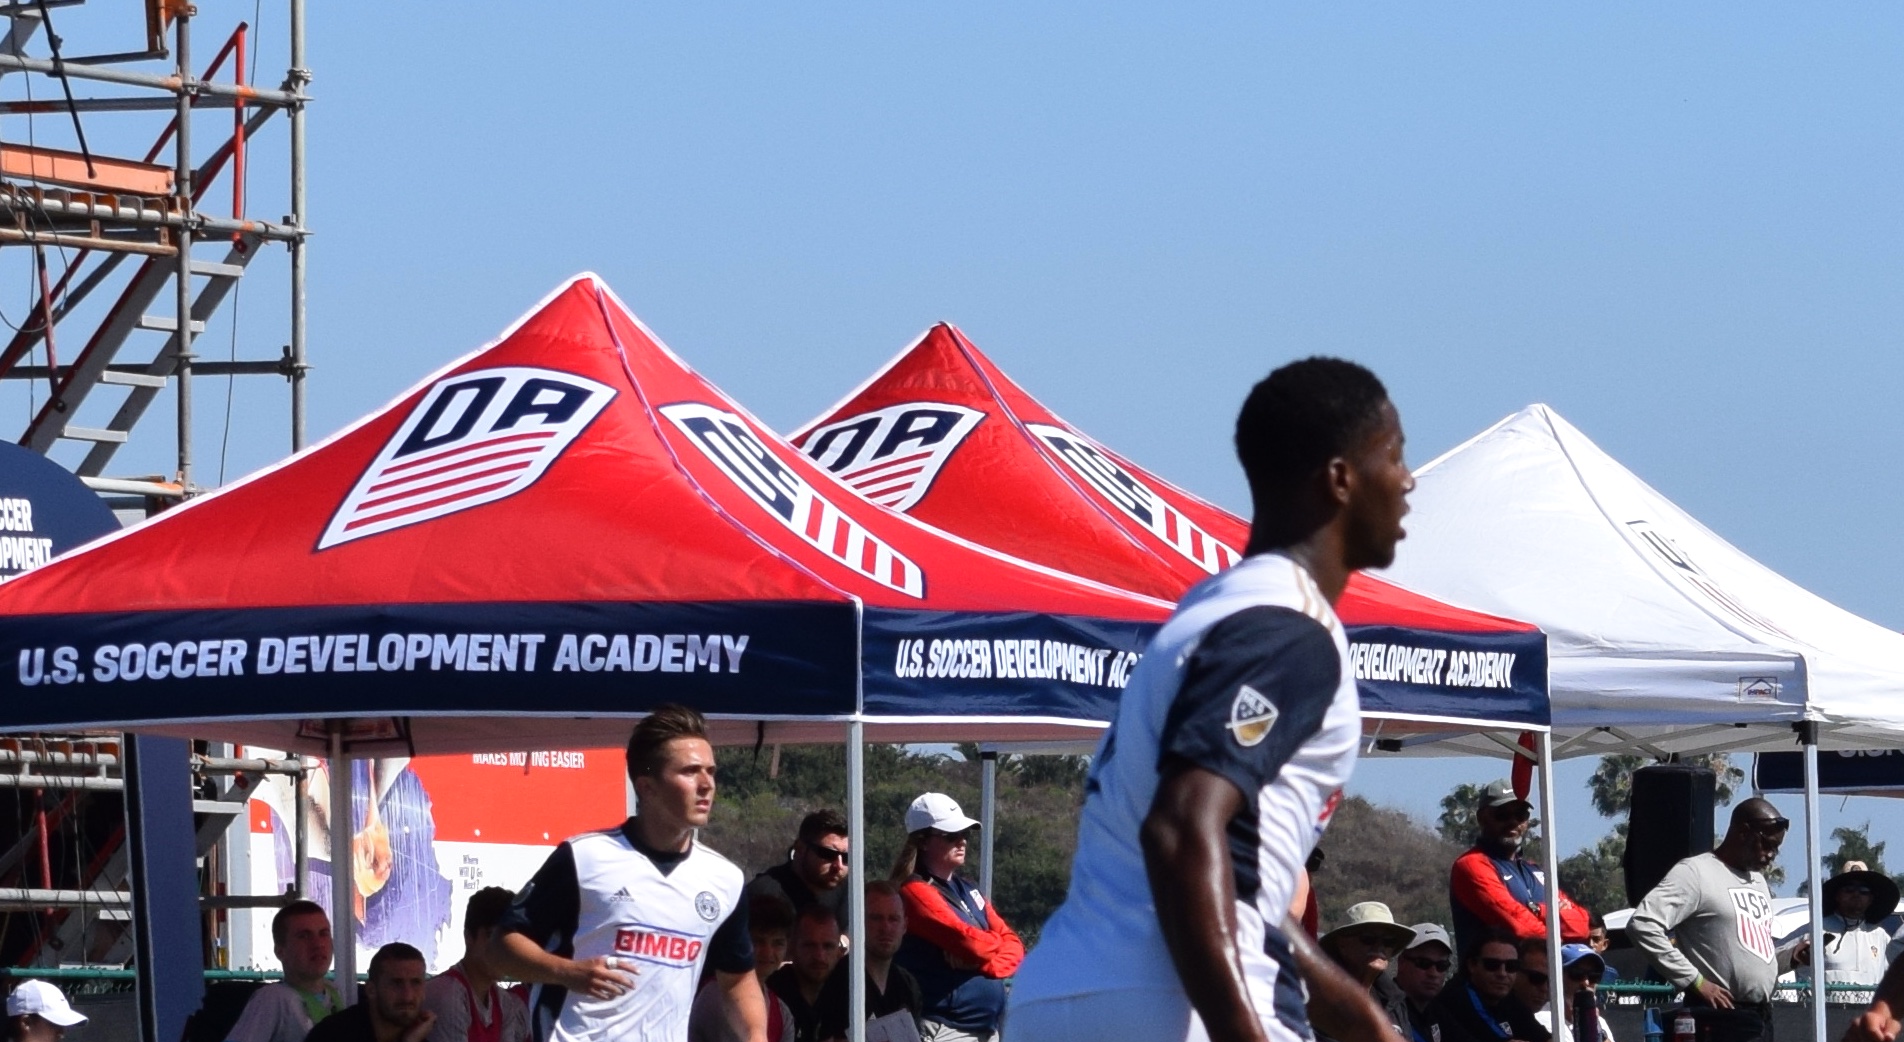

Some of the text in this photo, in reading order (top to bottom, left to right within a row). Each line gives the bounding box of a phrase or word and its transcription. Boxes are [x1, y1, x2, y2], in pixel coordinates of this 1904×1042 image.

[18, 632, 750, 686] U.S. SOCCER DEVELOPMENT ACADEMY
[894, 638, 1144, 689] U.S. SOCCER DEVELOPMENT AC
[1350, 642, 1517, 689] DEVELOPMENT ACADEMY
[509, 751, 549, 768] MOING
[550, 750, 585, 769] EASIER
[1733, 891, 1770, 920] USA
[614, 929, 703, 962] BIMBO
